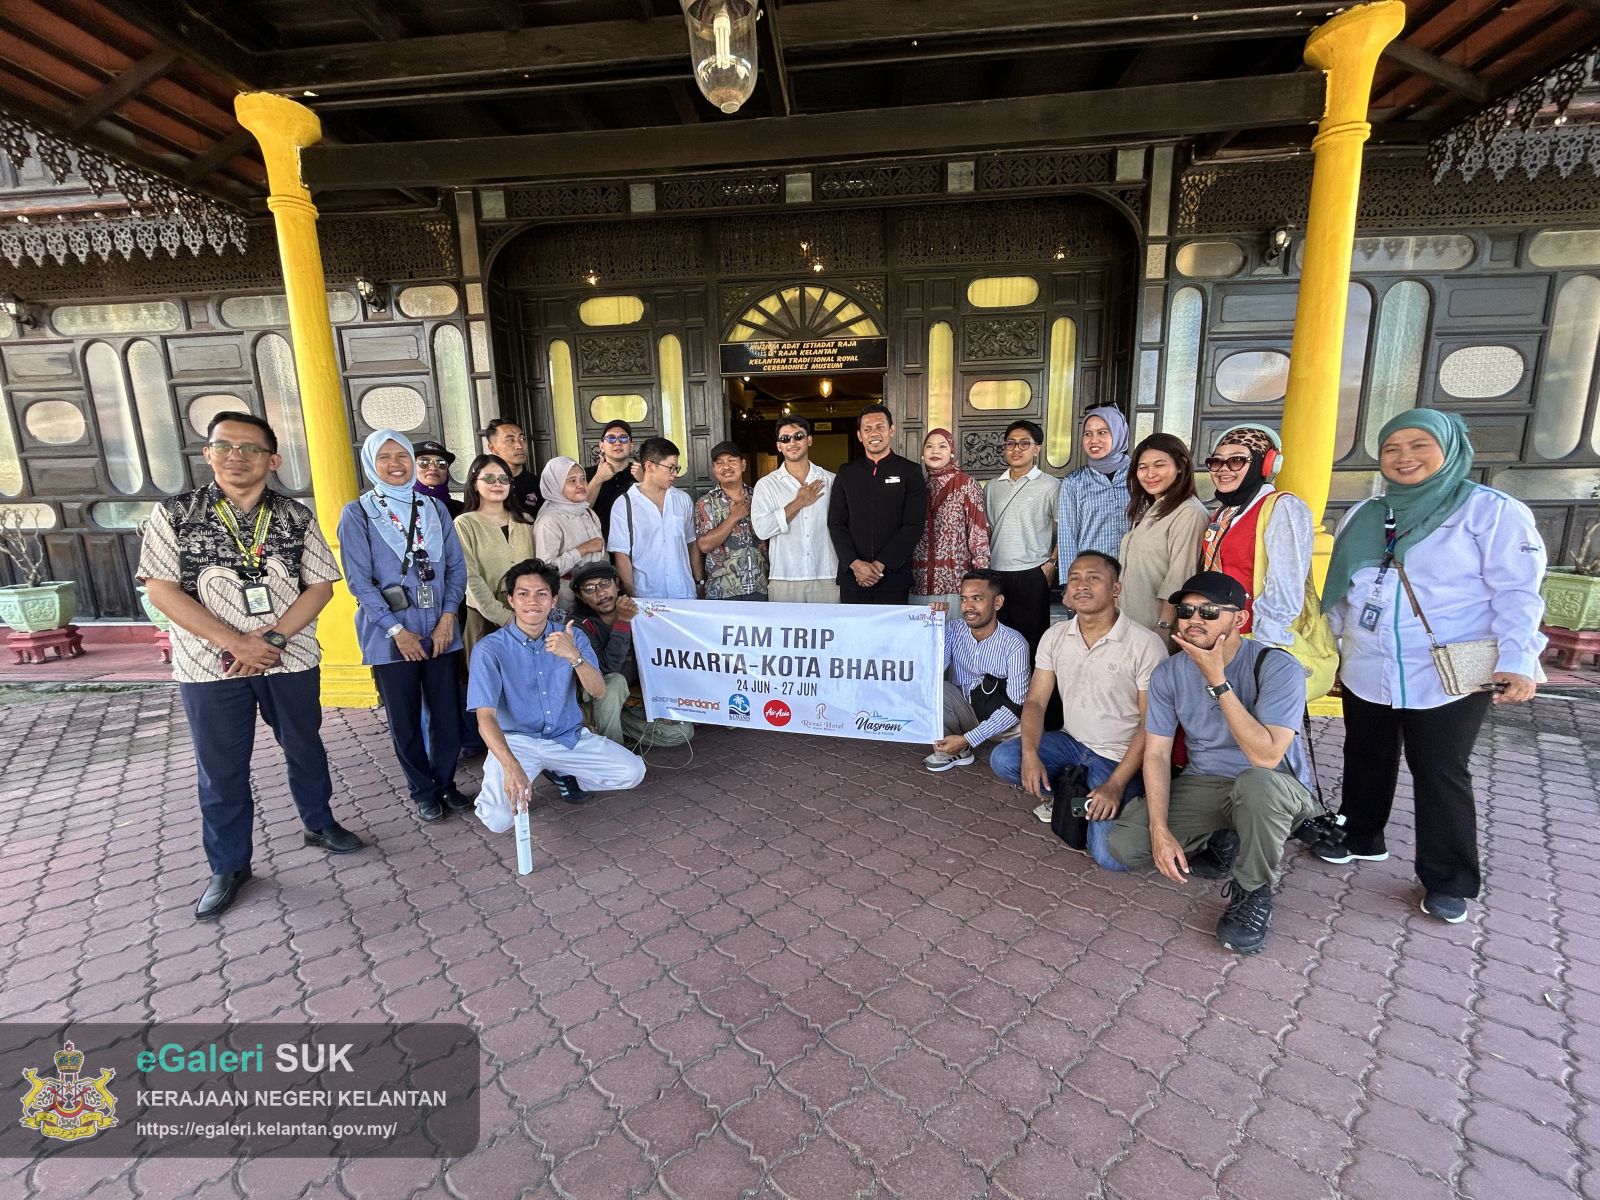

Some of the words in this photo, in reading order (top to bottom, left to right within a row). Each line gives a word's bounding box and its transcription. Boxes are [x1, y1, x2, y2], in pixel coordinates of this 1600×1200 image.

[782, 342, 800, 350] ADAT
[803, 341, 835, 349] ISTIADAT
[837, 340, 857, 348] RAJA
[778, 349, 797, 357] RAJA
[799, 348, 838, 356] KELANTAN
[748, 358, 786, 366] KELANTAN
[836, 355, 859, 363] ROYAL
[762, 363, 808, 371] CEREMONIES
[810, 362, 843, 370] MUSEUM
[721, 625, 773, 648] FAM
[780, 627, 835, 650] TRIP
[829, 657, 914, 682] BHARU
[737, 679, 749, 692] 24
[751, 680, 771, 694] JUN
[782, 681, 794, 695] 27
[797, 682, 817, 697] JUN
[677, 697, 720, 710] perdana
[855, 716, 903, 732] Nasrom
